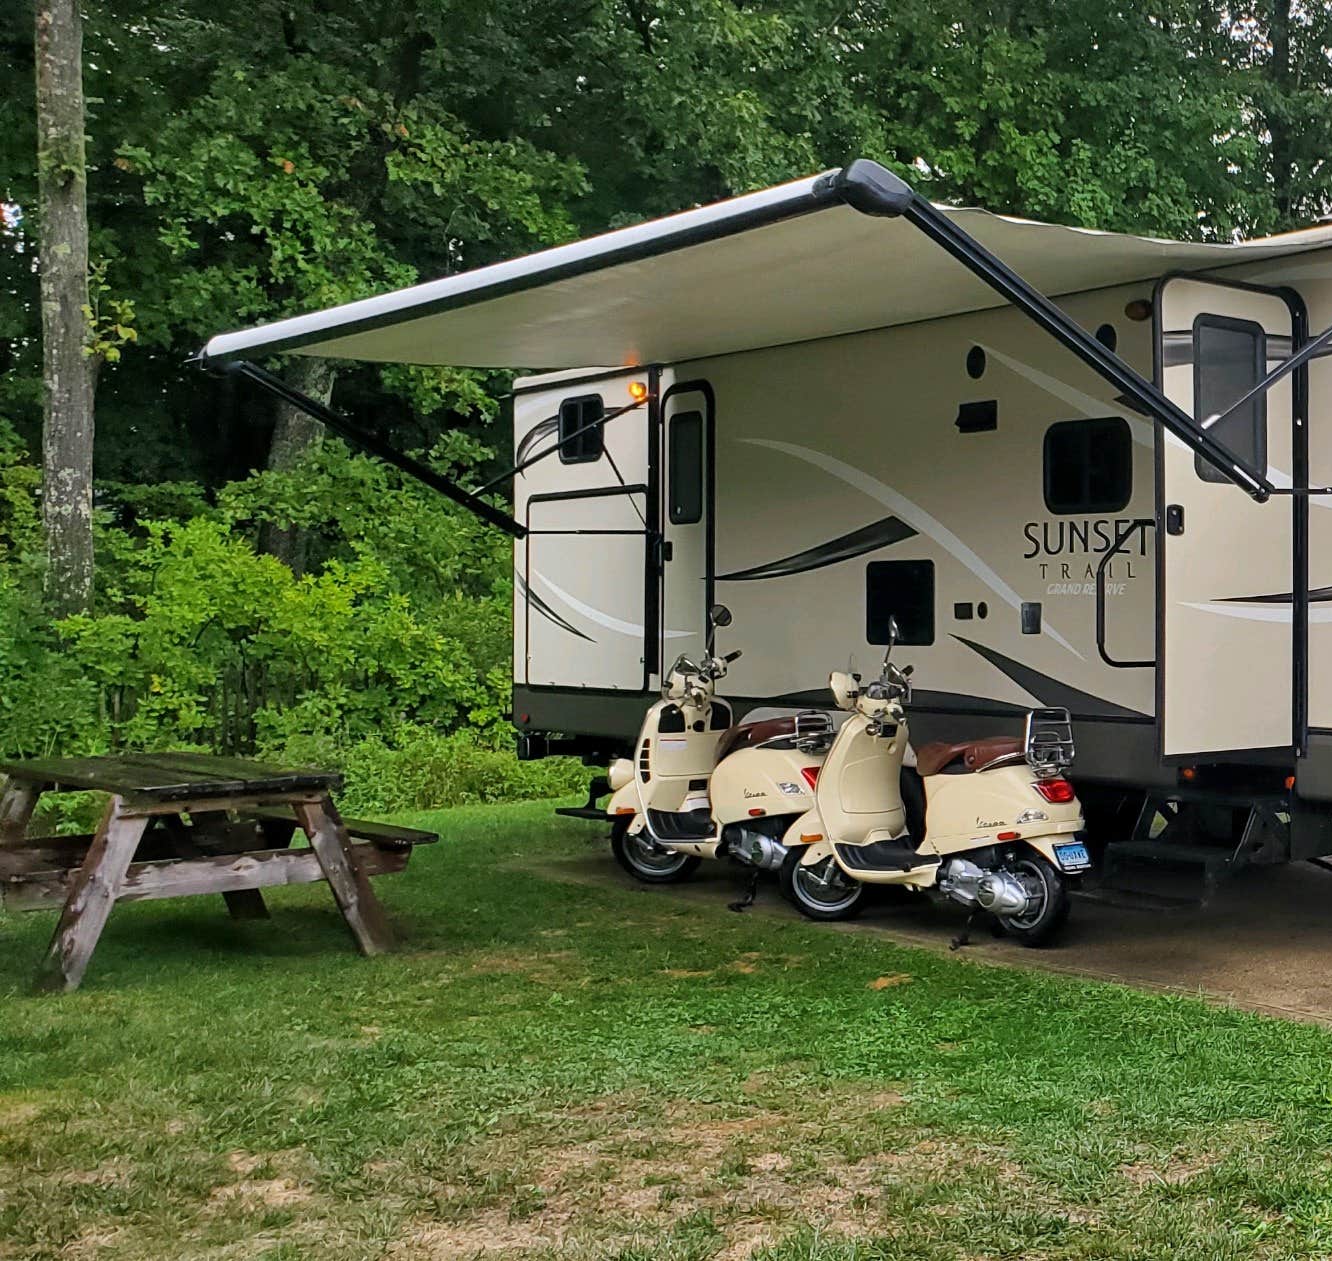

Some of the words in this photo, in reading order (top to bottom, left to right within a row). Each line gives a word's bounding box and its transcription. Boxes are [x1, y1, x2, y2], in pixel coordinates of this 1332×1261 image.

[1023, 519, 1150, 559] SUNSET
[1039, 562, 1136, 579] TRAIL
[1047, 583, 1081, 595] GRAND
[1082, 583, 1128, 595] RERVE
